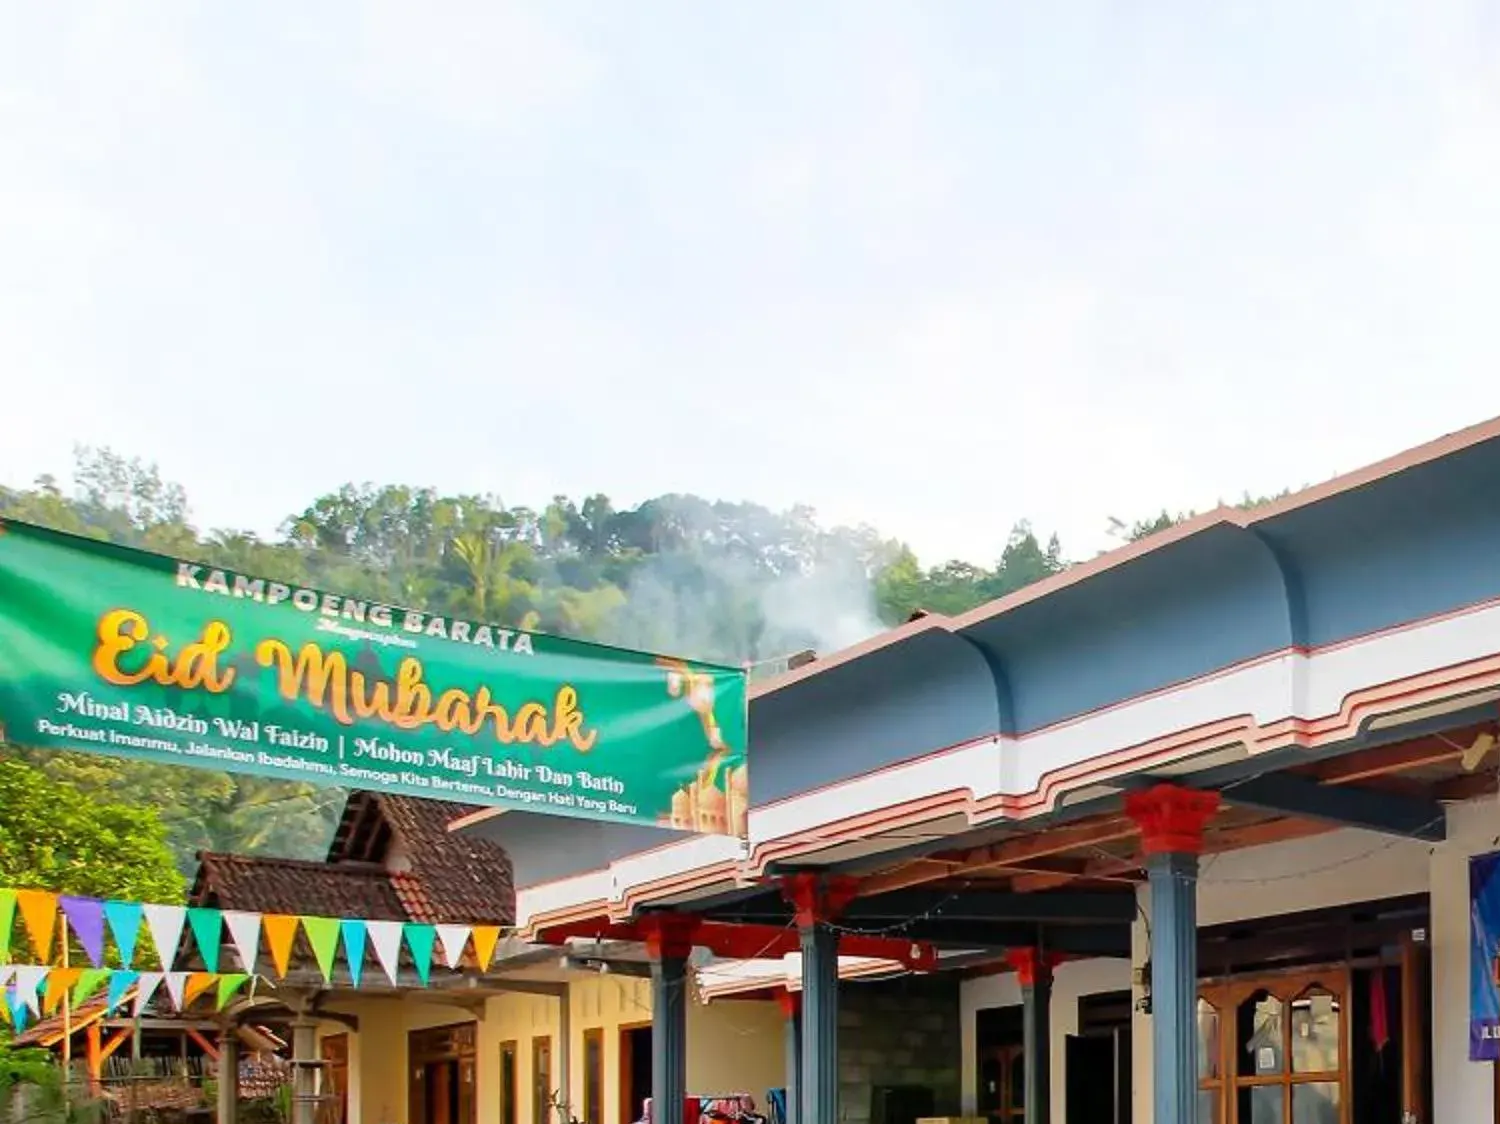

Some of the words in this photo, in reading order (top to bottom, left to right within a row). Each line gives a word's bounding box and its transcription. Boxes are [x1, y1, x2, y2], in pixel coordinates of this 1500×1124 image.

[176, 563, 393, 627] KAMPOENG
[403, 611, 534, 656] BARATA
[93, 608, 236, 693] Eid
[256, 638, 597, 752] Mubarak
[37, 719, 106, 742] Perkuat
[340, 763, 398, 784] Semoga
[401, 771, 429, 788] Kita
[496, 784, 546, 803] Dengan
[56, 692, 129, 722] Minal
[133, 705, 208, 735] Aidzin
[213, 717, 259, 742] Wal
[264, 725, 329, 752] Faizin
[353, 737, 424, 767] Mohon
[427, 748, 480, 777] Maaf
[481, 757, 532, 781] Lahir
[535, 765, 572, 787] Dan
[576, 771, 625, 794] Batin
